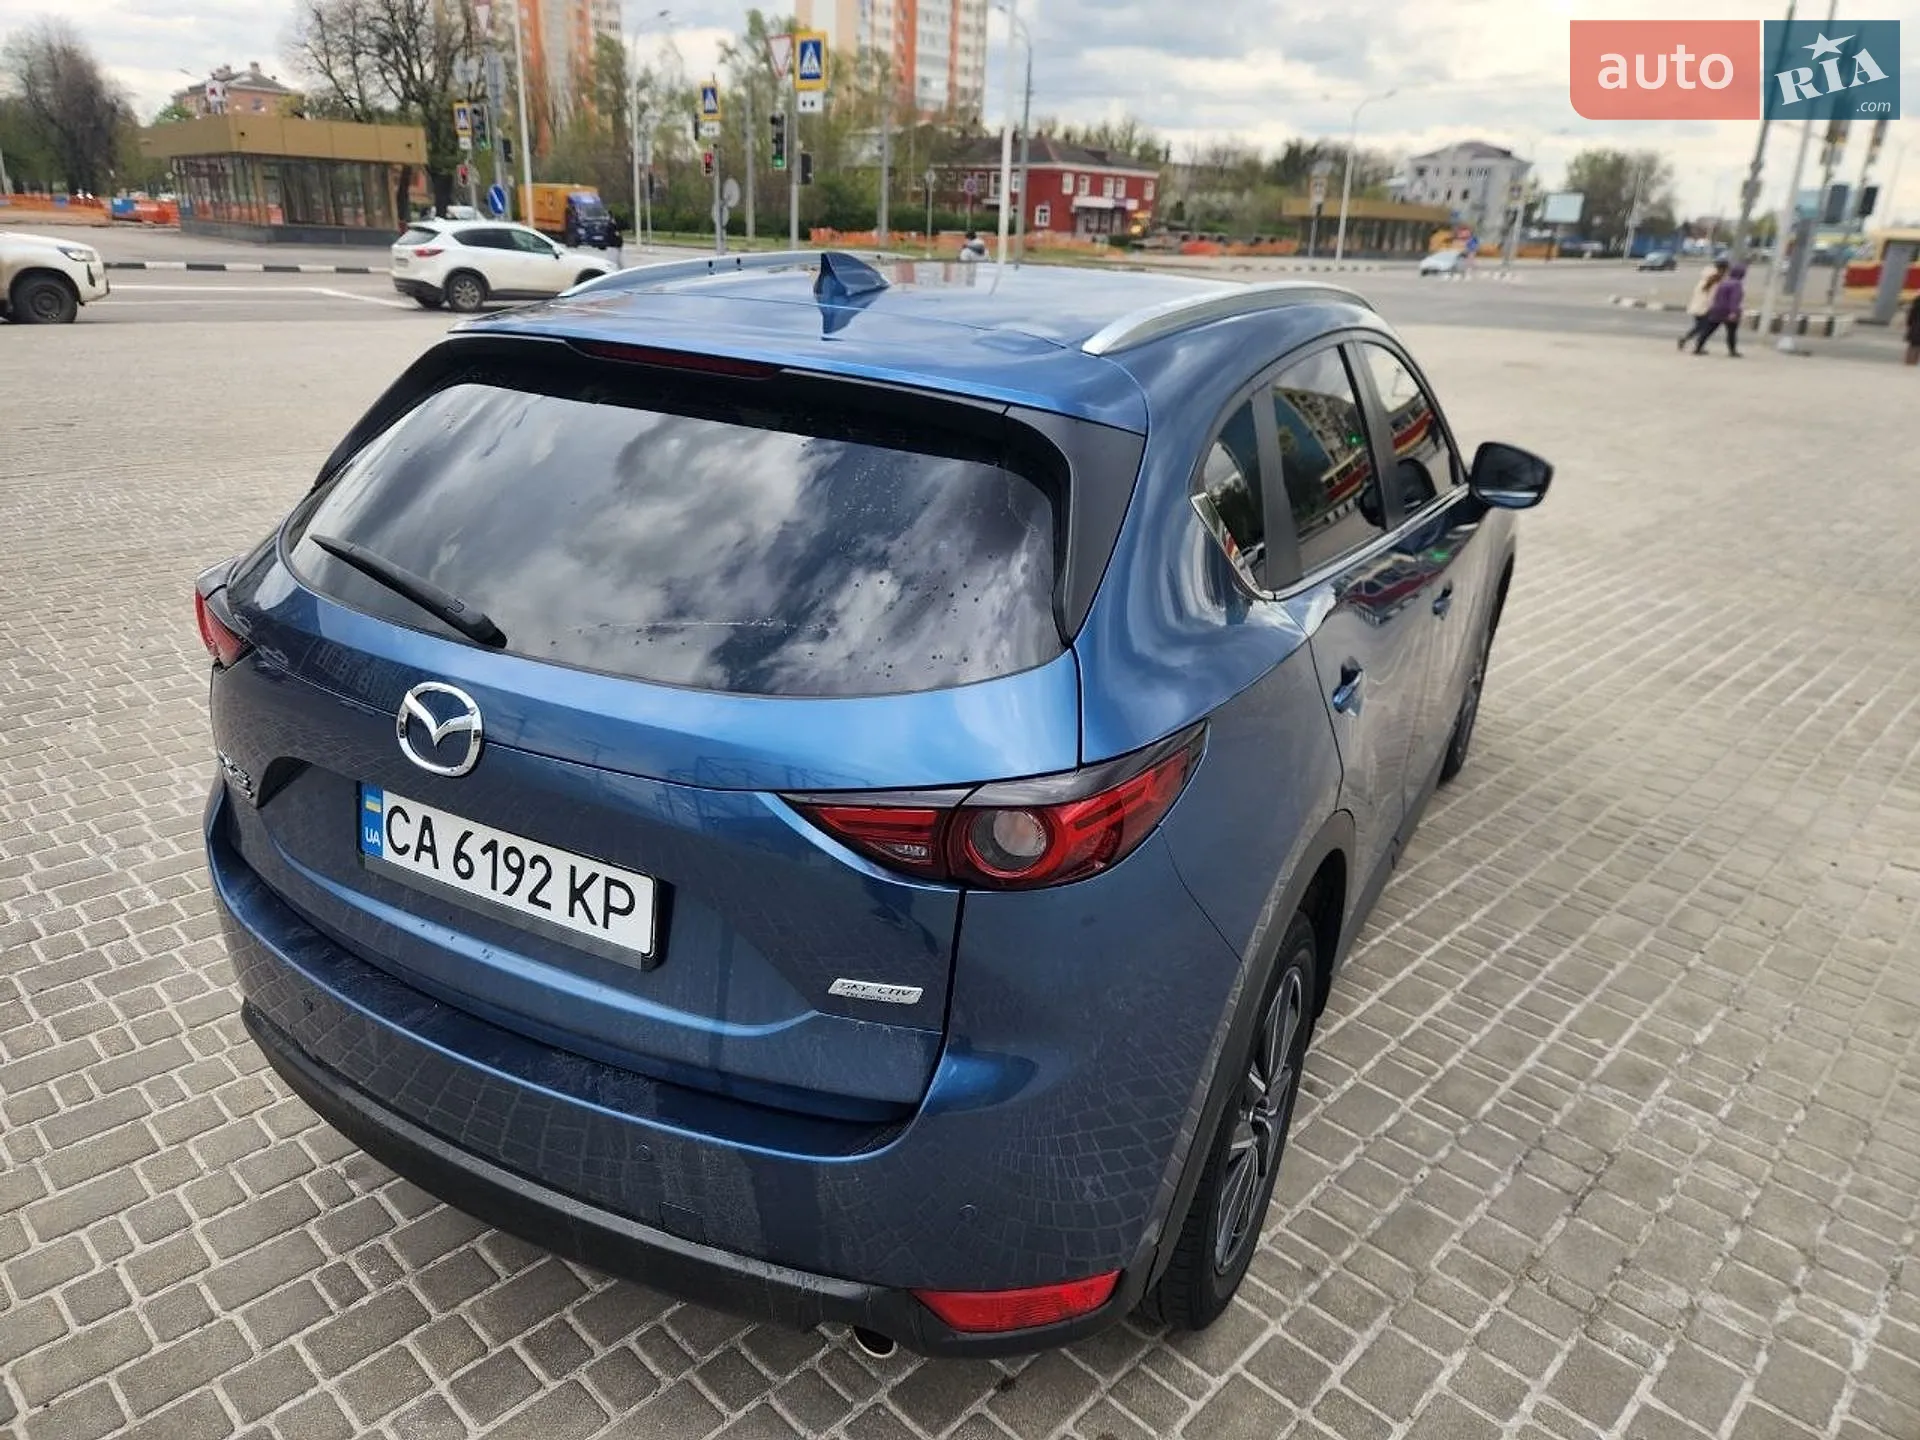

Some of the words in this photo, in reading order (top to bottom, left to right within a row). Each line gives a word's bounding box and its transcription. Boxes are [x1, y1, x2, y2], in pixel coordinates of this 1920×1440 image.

[365, 827, 380, 847] UA
[385, 805, 440, 870] CA
[453, 830, 552, 911] 6192
[568, 863, 636, 930] KP
